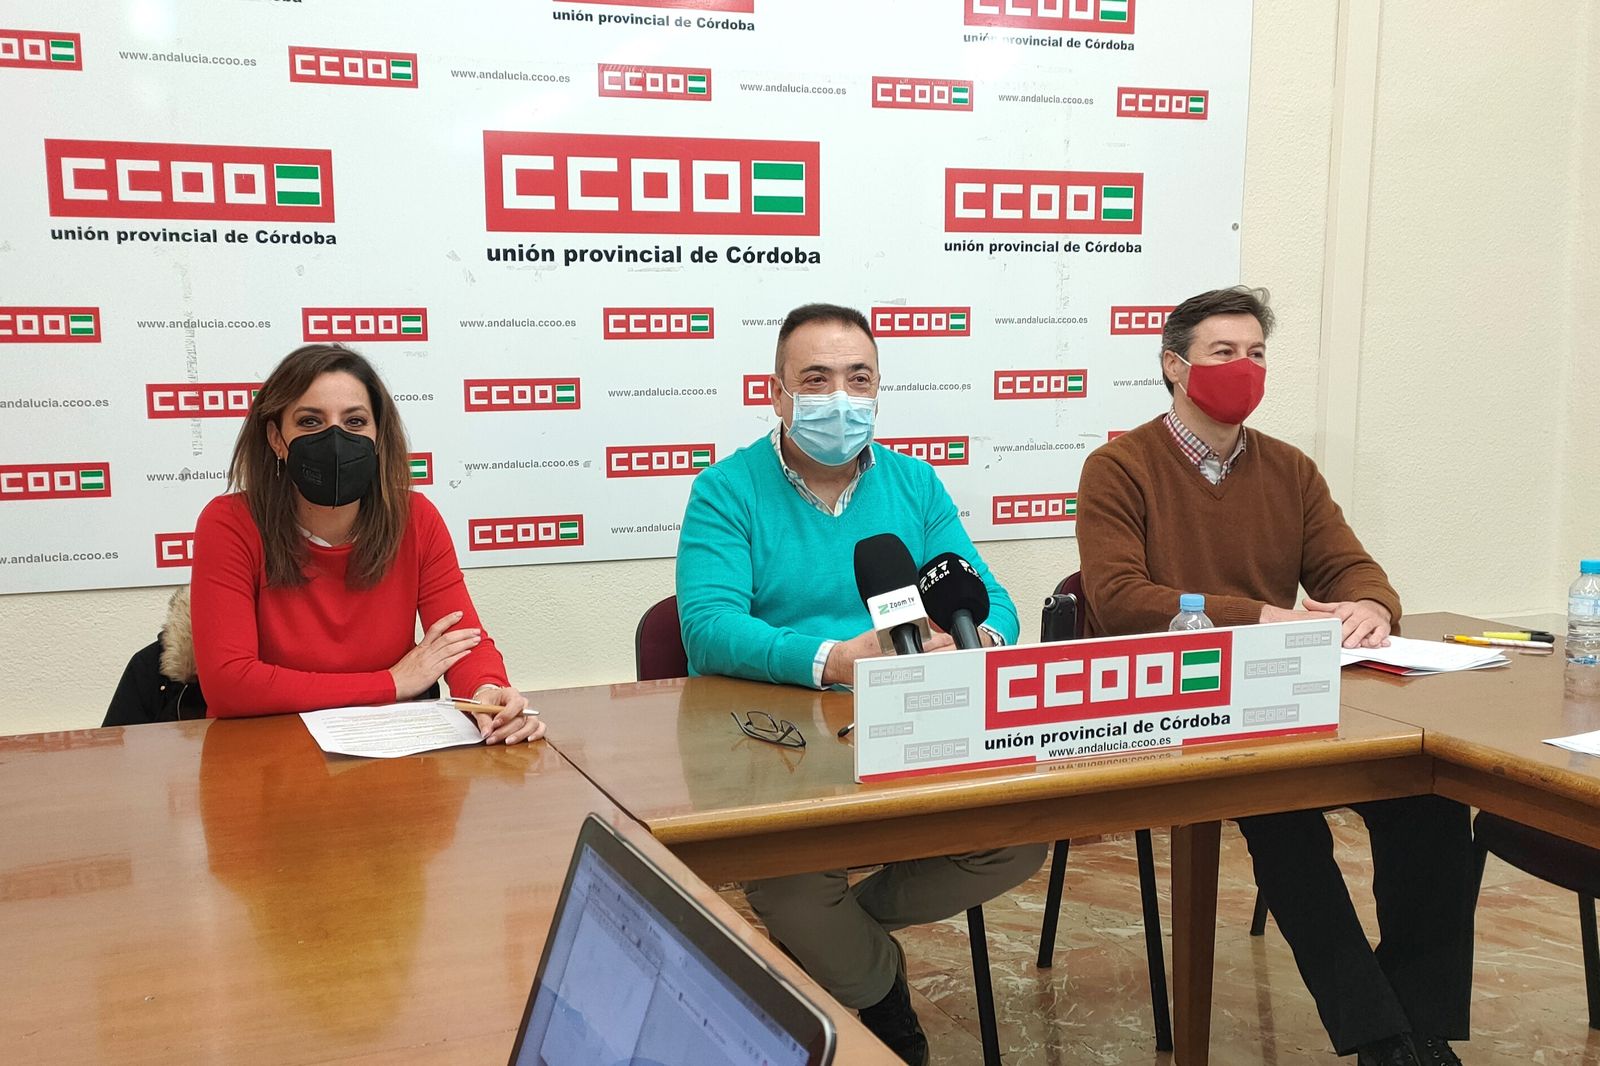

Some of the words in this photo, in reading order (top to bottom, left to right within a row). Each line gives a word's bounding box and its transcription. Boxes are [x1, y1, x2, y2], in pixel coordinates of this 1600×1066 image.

[552, 9, 594, 22] unión
[599, 13, 669, 26] provincial
[674, 15, 692, 28] de
[697, 18, 754, 31] Córdoba
[963, 32, 998, 43] uni
[1066, 37, 1082, 49] de
[1084, 38, 1135, 51] Córdoba
[119, 51, 256, 66] www.andalucia.ccoo.es
[295, 54, 387, 79] CCOO
[451, 70, 570, 83] www.andalucia.ccoo.es
[604, 71, 684, 93] CCOO
[739, 83, 847, 96] www.andalucia.ccoo.es
[877, 84, 949, 103] CCOO
[998, 93, 1094, 105] www.andalucia.ccoo.es
[1121, 93, 1186, 113] CCOO
[61, 158, 266, 204] CCOO
[502, 154, 741, 213] CCOO
[955, 183, 1096, 220] CCOO
[51, 226, 109, 240] unión
[117, 228, 217, 244] provincial
[225, 230, 248, 243] de
[256, 230, 336, 244] Córdoba
[487, 244, 554, 261] unión
[564, 245, 681, 266] provincial
[691, 246, 718, 263] de
[726, 246, 820, 264] Córdoba
[944, 239, 985, 252] unión
[990, 241, 1058, 254] provincial
[1063, 240, 1081, 253] de
[1085, 241, 1141, 253] Córdoba
[137, 319, 271, 331] www.andalucia.ccoo.es
[309, 315, 398, 334] CCOO
[459, 318, 577, 328] www.andalucia.ccoo.es
[609, 314, 687, 333] CCOO
[876, 313, 947, 331] CCOO
[994, 315, 1089, 325] www.andalucia.ccoo.es
[607, 387, 718, 398] www.andalucia.ccoo.es
[998, 376, 1065, 393] CCOO
[153, 391, 249, 411] CCOO
[470, 385, 552, 404] CCOO
[991, 440, 1087, 453] www.andalucia.ccoo.es
[464, 459, 580, 471] www.andalucia.ccoo.es
[611, 451, 689, 471] CCOO
[997, 500, 1062, 518] CCOO
[474, 523, 556, 544] CCOO
[890, 599, 907, 609] Zoom
[997, 652, 1173, 712] CCOO
[985, 733, 1034, 750] unión
[1041, 721, 1127, 747] provincial
[1133, 720, 1154, 733] de
[1160, 712, 1231, 731] Córdoba
[1048, 736, 1172, 757] www.andalucia.ccoo.es
